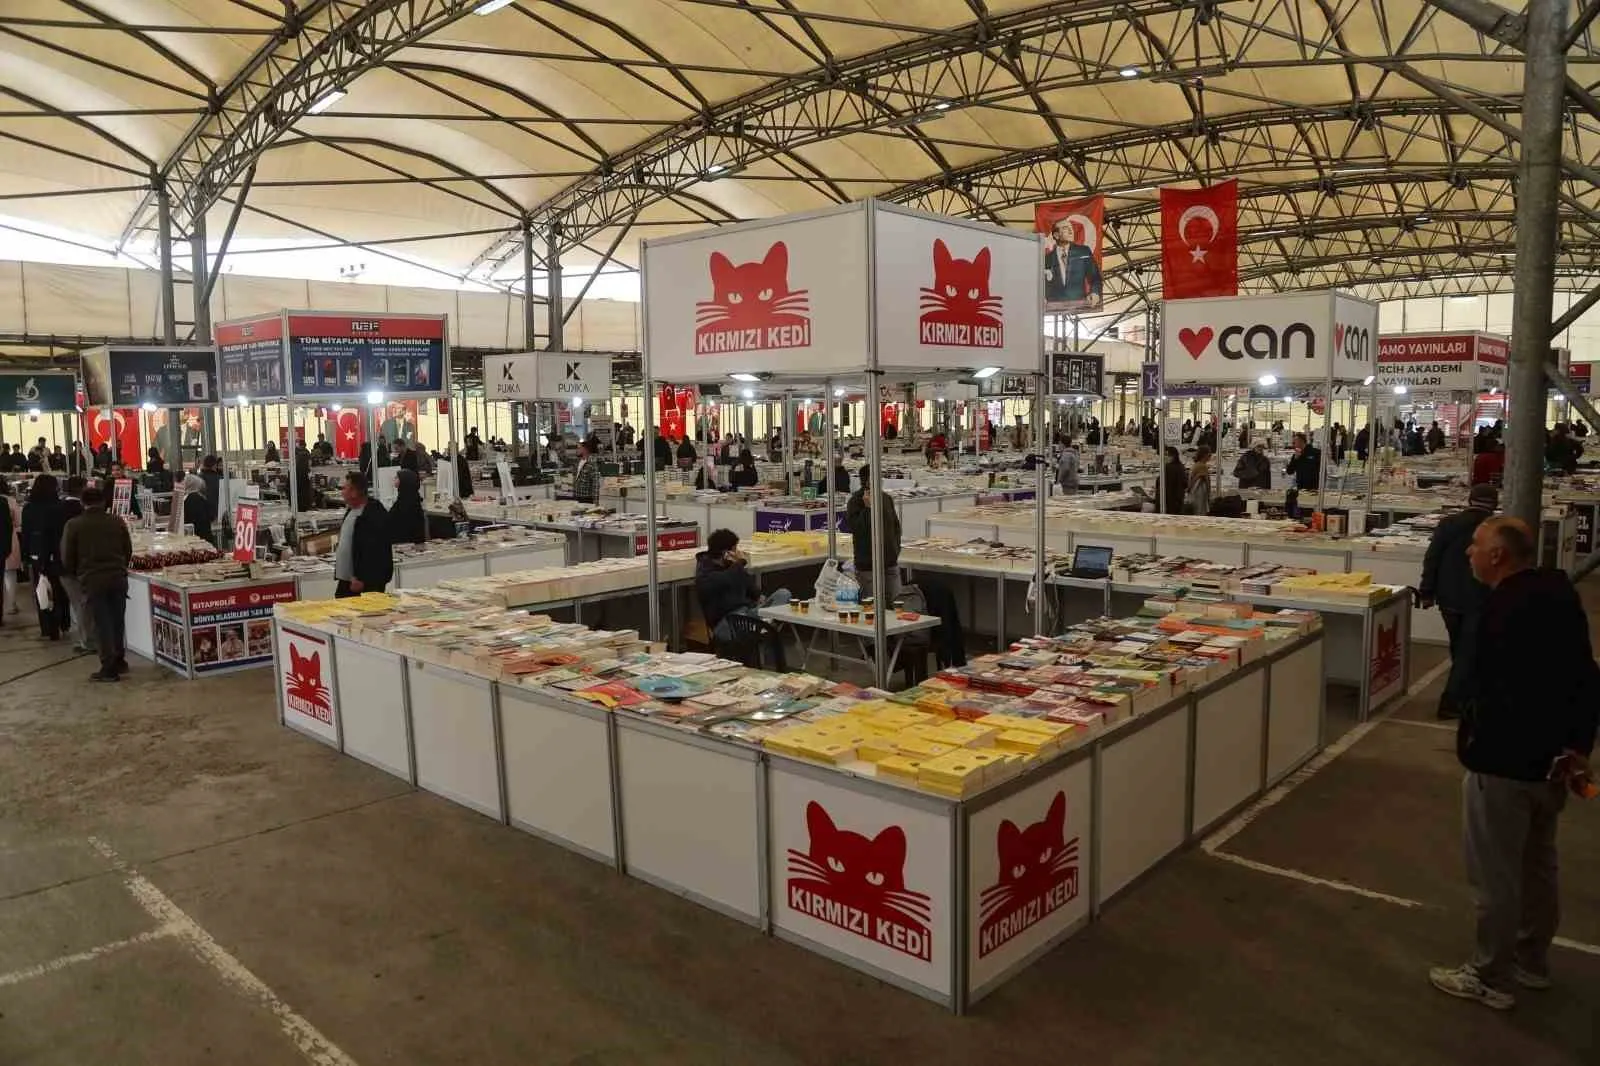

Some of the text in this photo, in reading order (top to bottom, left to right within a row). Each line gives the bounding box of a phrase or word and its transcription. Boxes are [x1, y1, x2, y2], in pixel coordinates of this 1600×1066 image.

[322, 337, 364, 345] KİTAPLAR
[698, 319, 809, 353] KIRMIZI KEDİ
[922, 321, 1002, 347] KIRMIZI KEDİ
[1217, 322, 1315, 360] can
[1344, 325, 1369, 361] can
[1378, 344, 1406, 355] AMO
[1409, 341, 1466, 354] YAYINLARI
[1378, 362, 1462, 374] RCİH AKADEMİ
[1383, 376, 1441, 386] YAYINLARI
[235, 520, 254, 551] 80
[791, 885, 930, 960] KIRMIZI KEDİ
[981, 868, 1079, 951] KIRMIZI KEDİ
